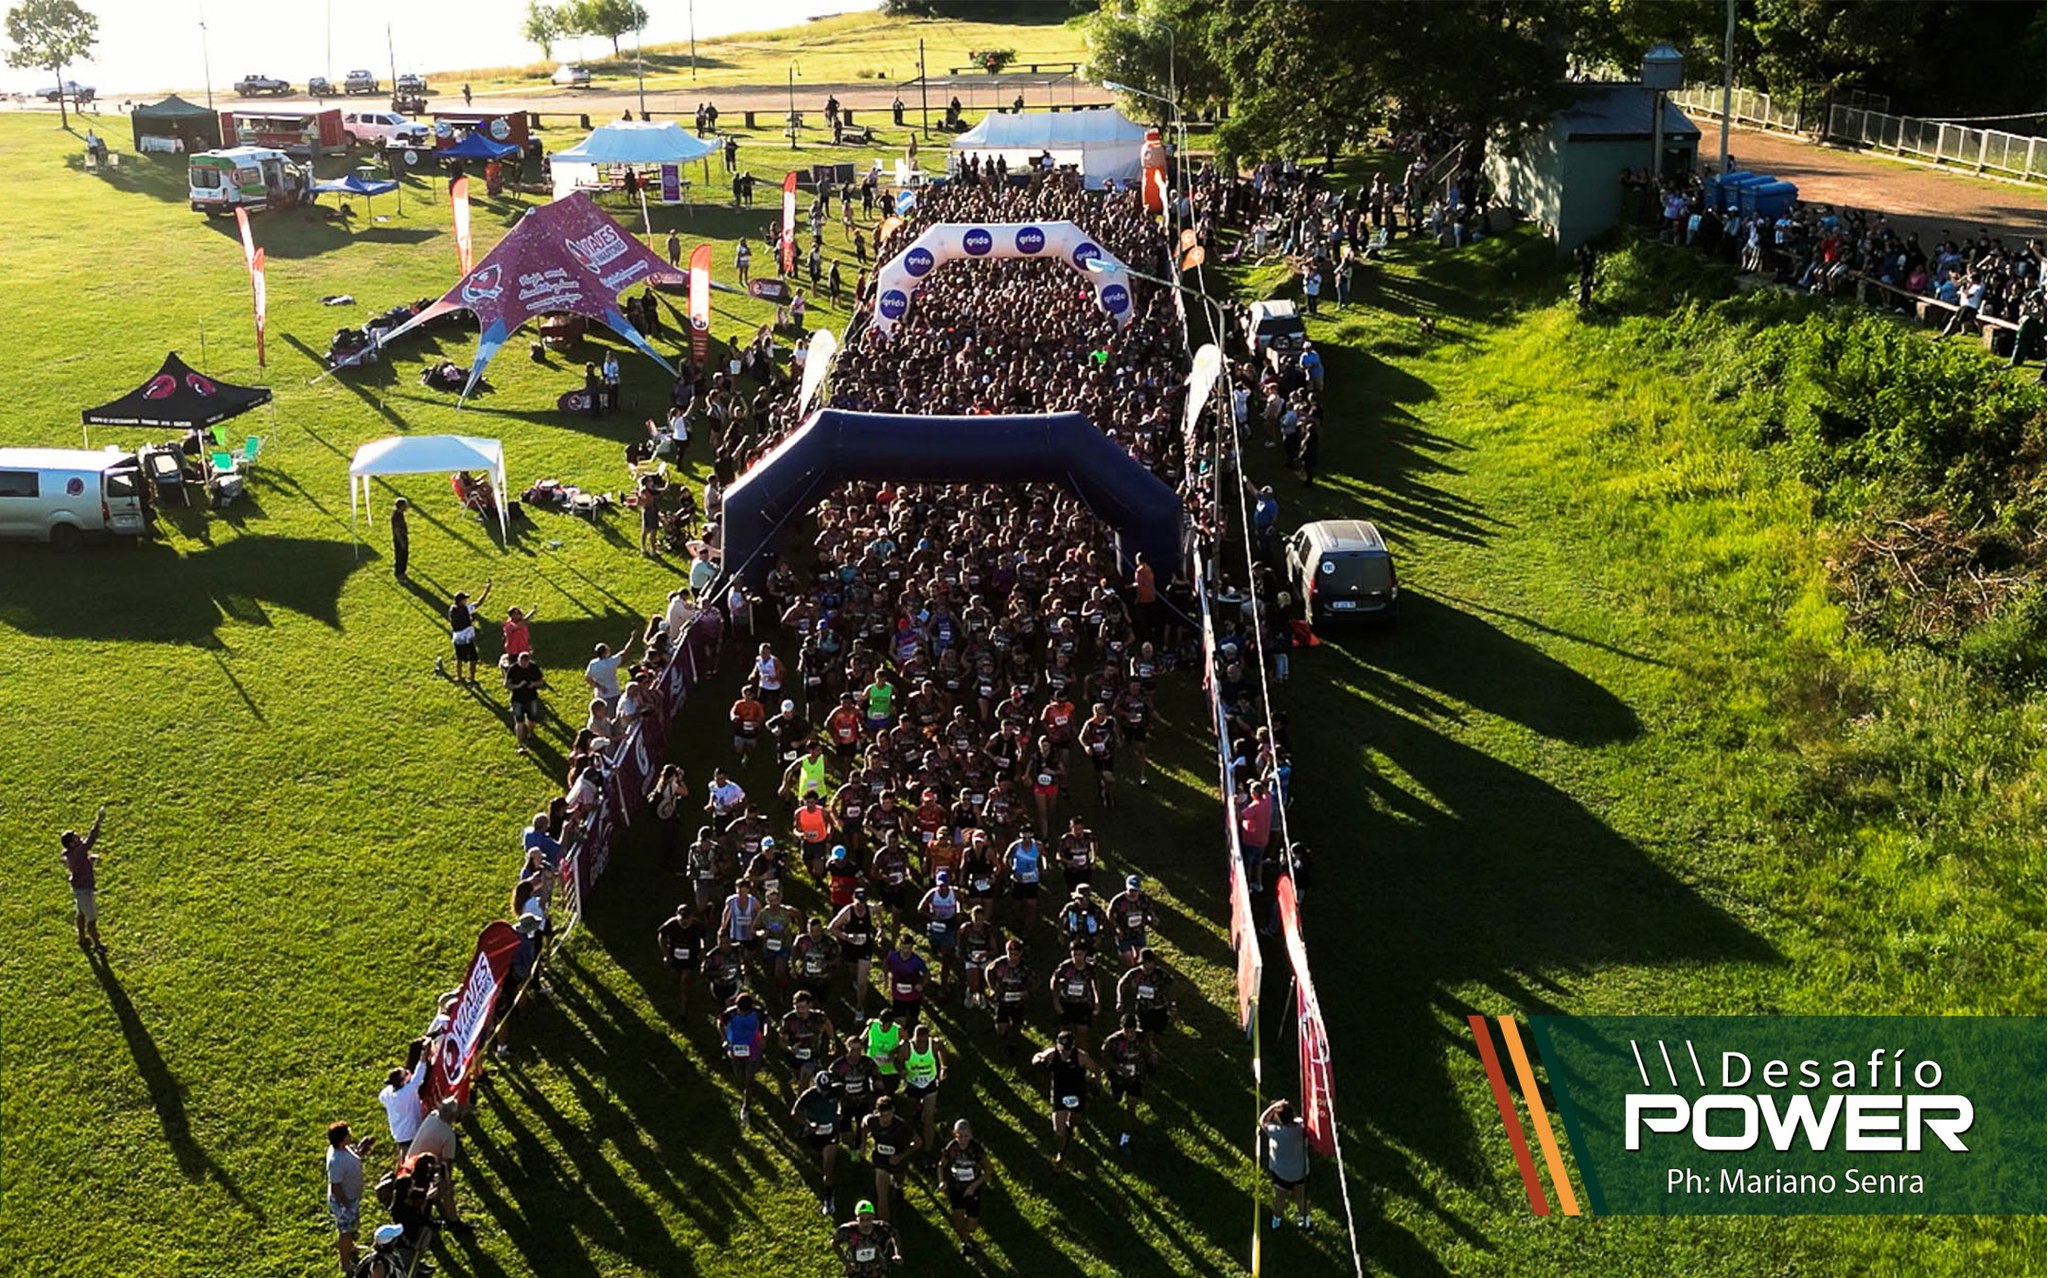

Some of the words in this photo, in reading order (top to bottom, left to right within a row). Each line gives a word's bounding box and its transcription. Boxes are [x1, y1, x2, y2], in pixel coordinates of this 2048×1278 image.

[966, 236, 990, 247] grido
[1019, 234, 1042, 245] grido
[454, 954, 489, 1034] VIAJES
